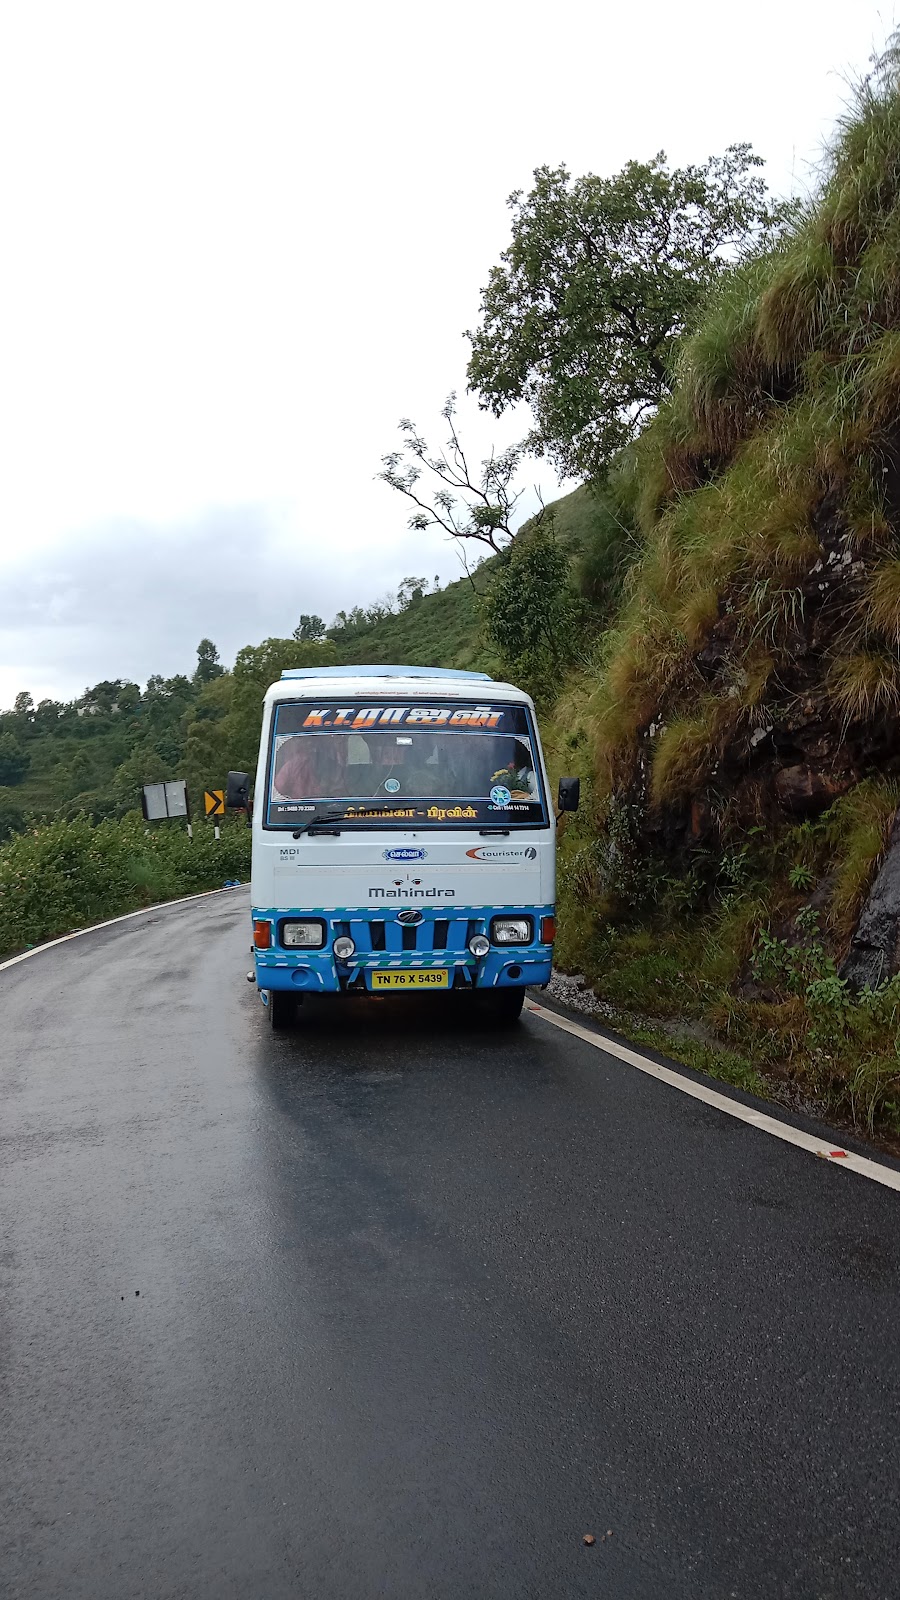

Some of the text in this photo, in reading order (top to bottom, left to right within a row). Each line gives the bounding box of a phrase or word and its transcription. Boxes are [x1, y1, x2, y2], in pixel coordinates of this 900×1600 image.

[427, 806, 478, 821] பிரவின்
[368, 887, 455, 898] Mahindra
[376, 974, 442, 984] TN 76 X 5439
